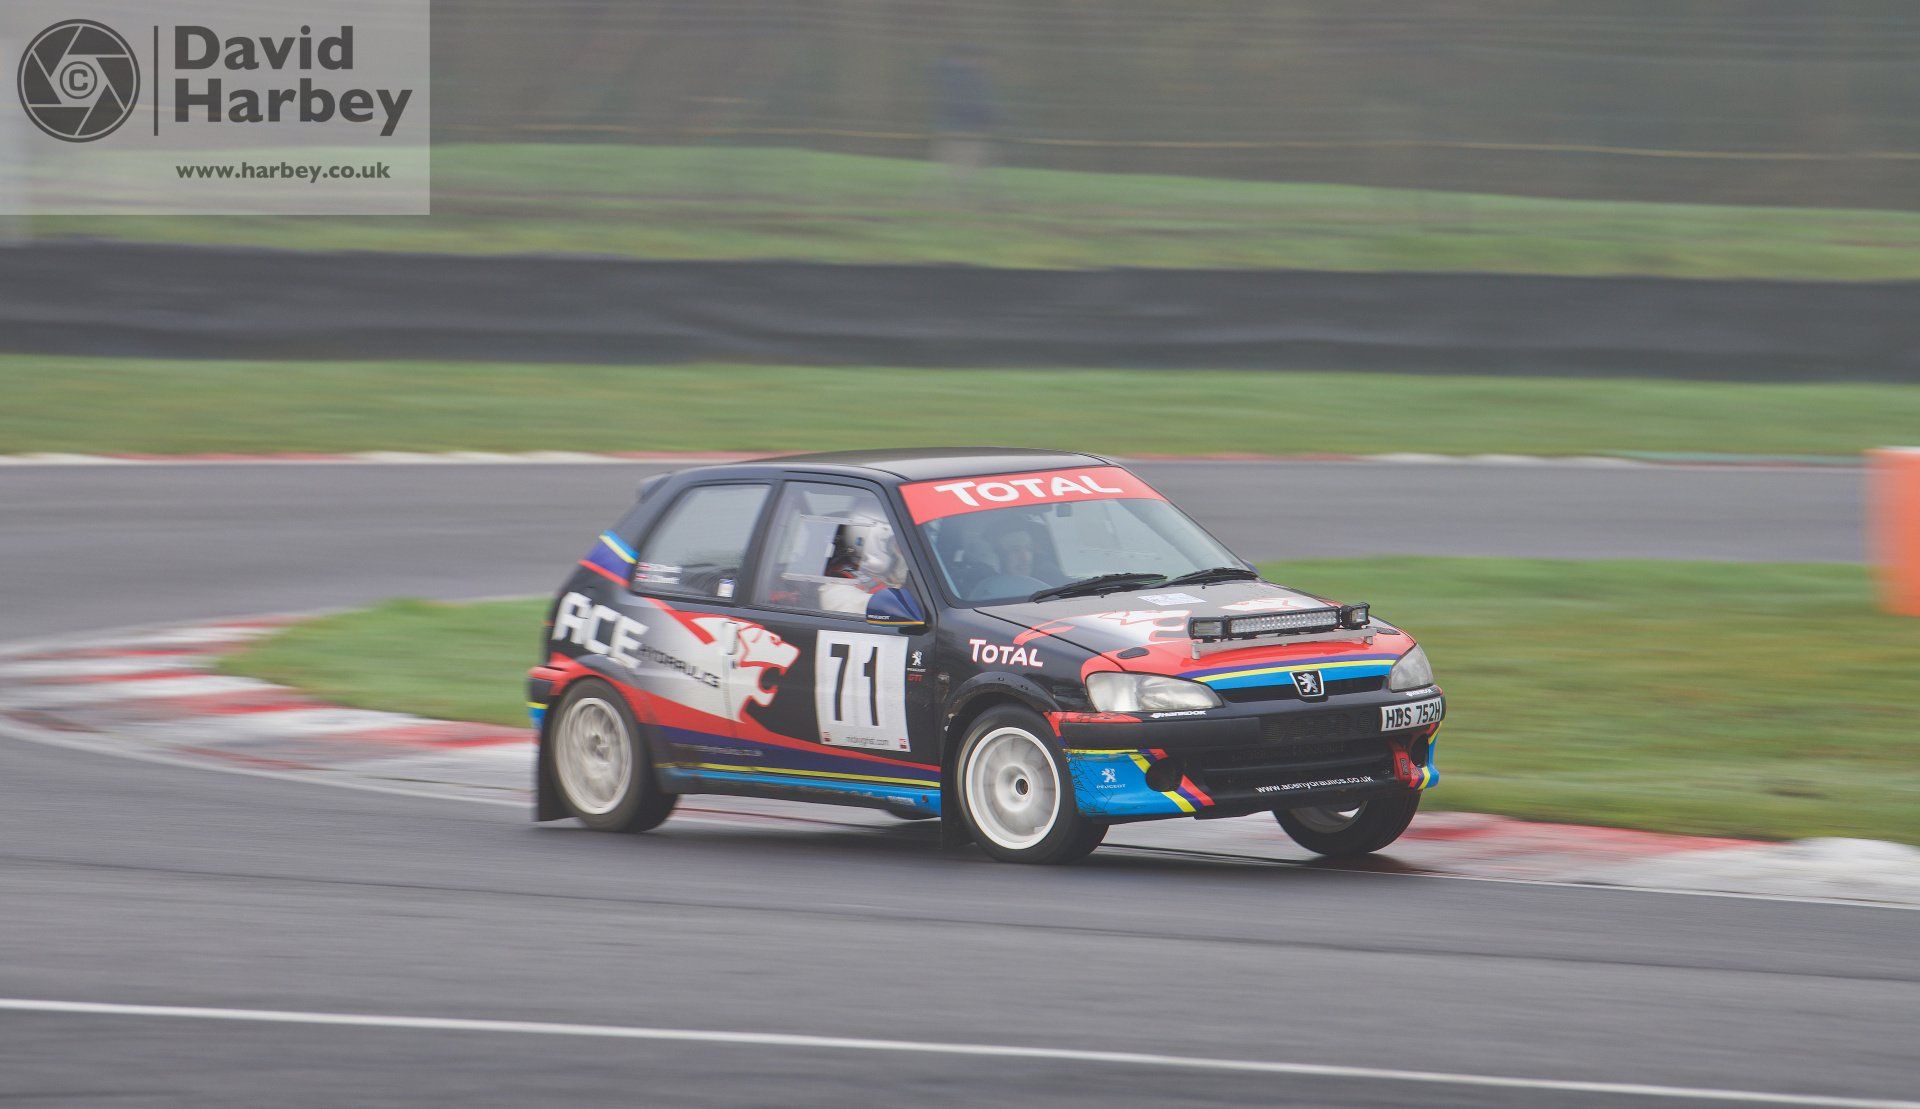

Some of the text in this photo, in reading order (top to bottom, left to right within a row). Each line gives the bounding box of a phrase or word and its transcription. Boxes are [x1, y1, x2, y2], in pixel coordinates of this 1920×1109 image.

[933, 474, 1124, 506] TOTAL
[552, 591, 649, 669] ACE
[968, 638, 1044, 668] TOTAL
[830, 643, 879, 726] 71
[1415, 700, 1441, 725] 752H
